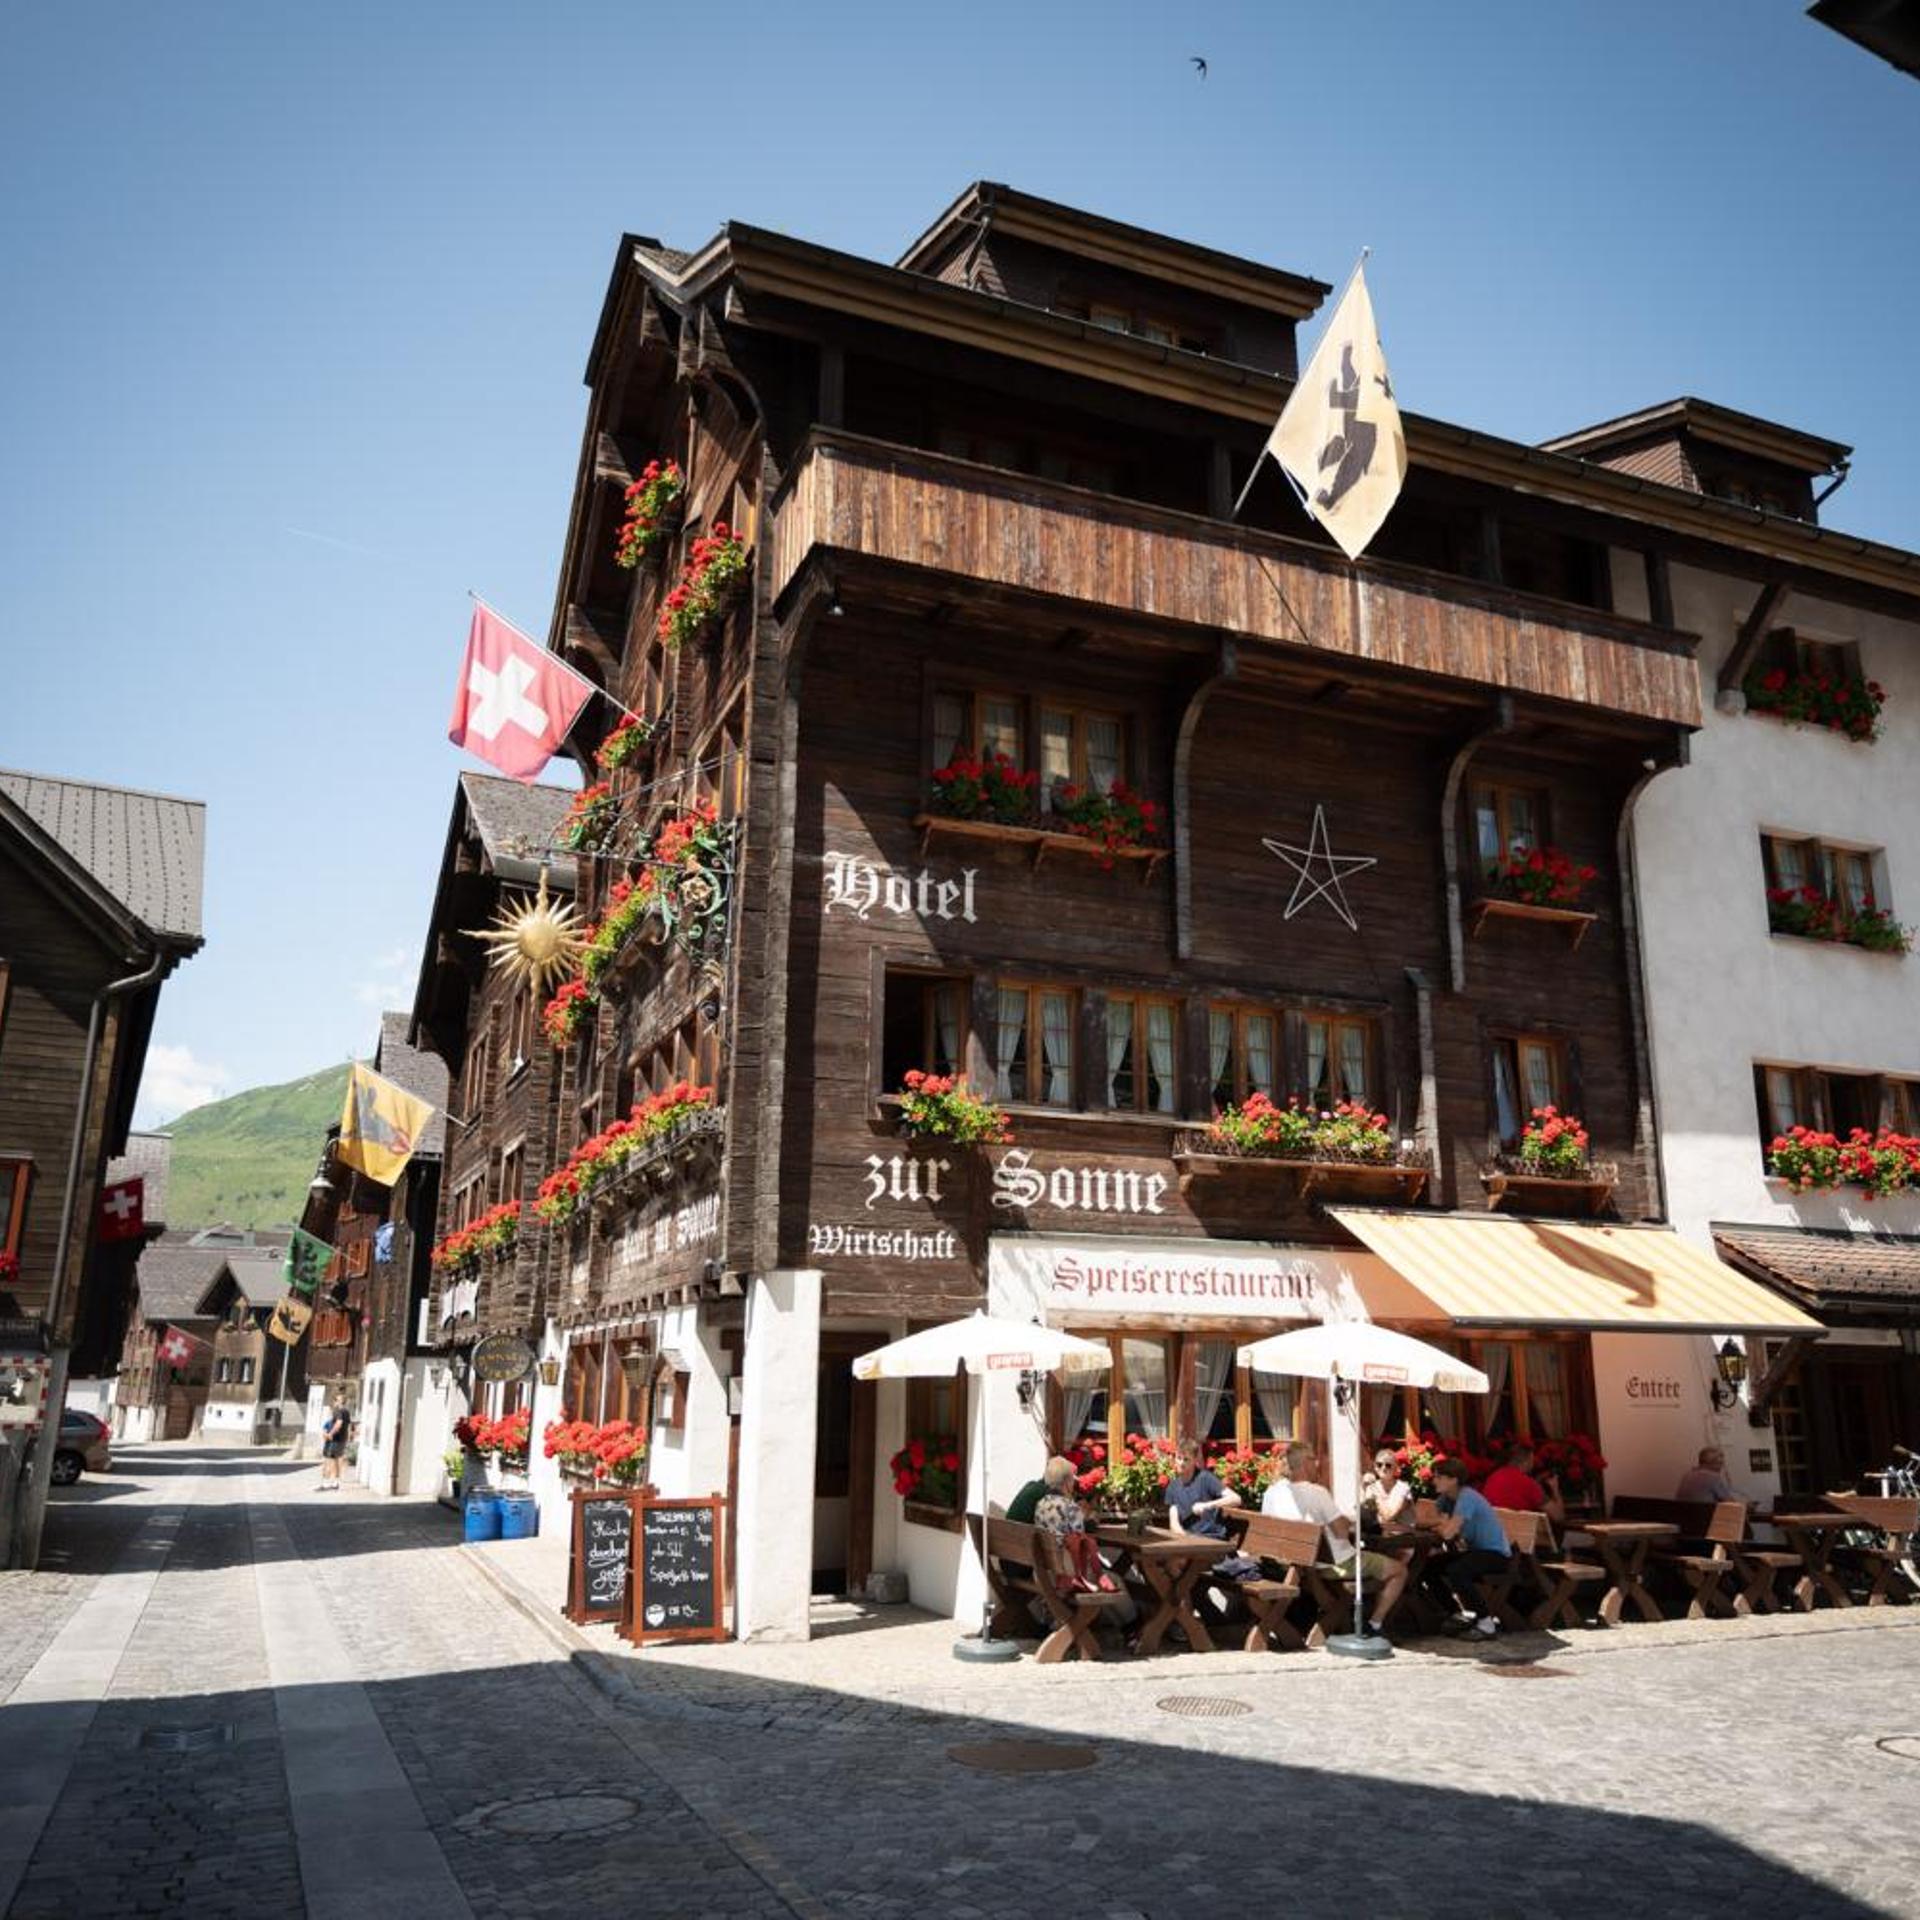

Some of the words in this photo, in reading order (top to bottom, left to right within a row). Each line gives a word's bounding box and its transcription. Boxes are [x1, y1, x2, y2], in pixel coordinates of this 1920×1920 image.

[823, 851, 979, 924] Hotel
[863, 1154, 952, 1210] zur
[991, 1148, 1168, 1215] Sonne
[809, 1224, 957, 1260] Wirtschaft
[1051, 1256, 1316, 1299] Speiserestaurant
[1625, 1375, 1680, 1398] Entrée
